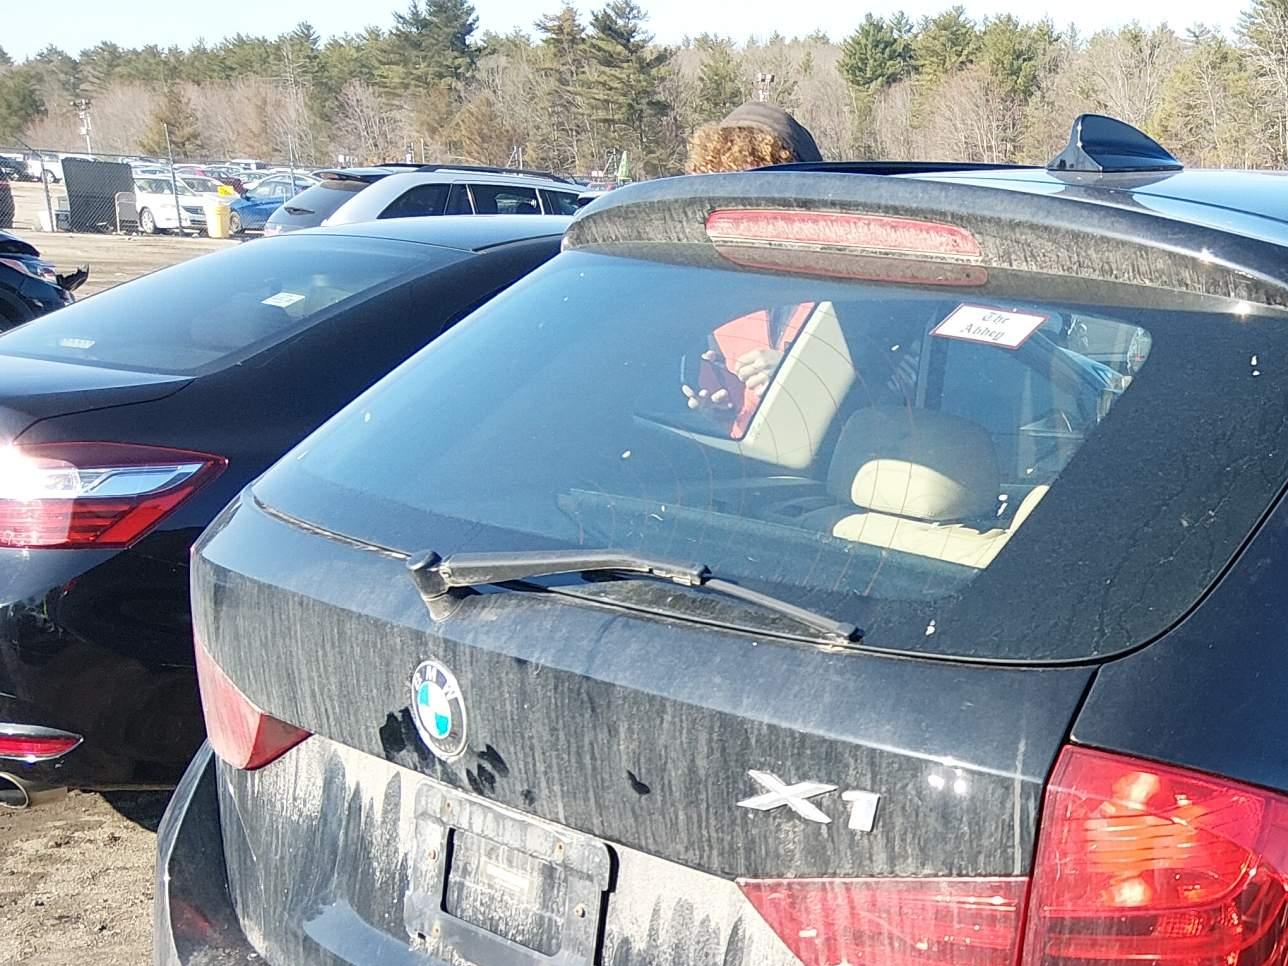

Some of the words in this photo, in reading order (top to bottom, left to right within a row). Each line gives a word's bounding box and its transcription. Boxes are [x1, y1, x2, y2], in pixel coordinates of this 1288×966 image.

[981, 311, 1011, 324] The
[959, 323, 1006, 341] Abbey
[736, 769, 881, 832] X1
